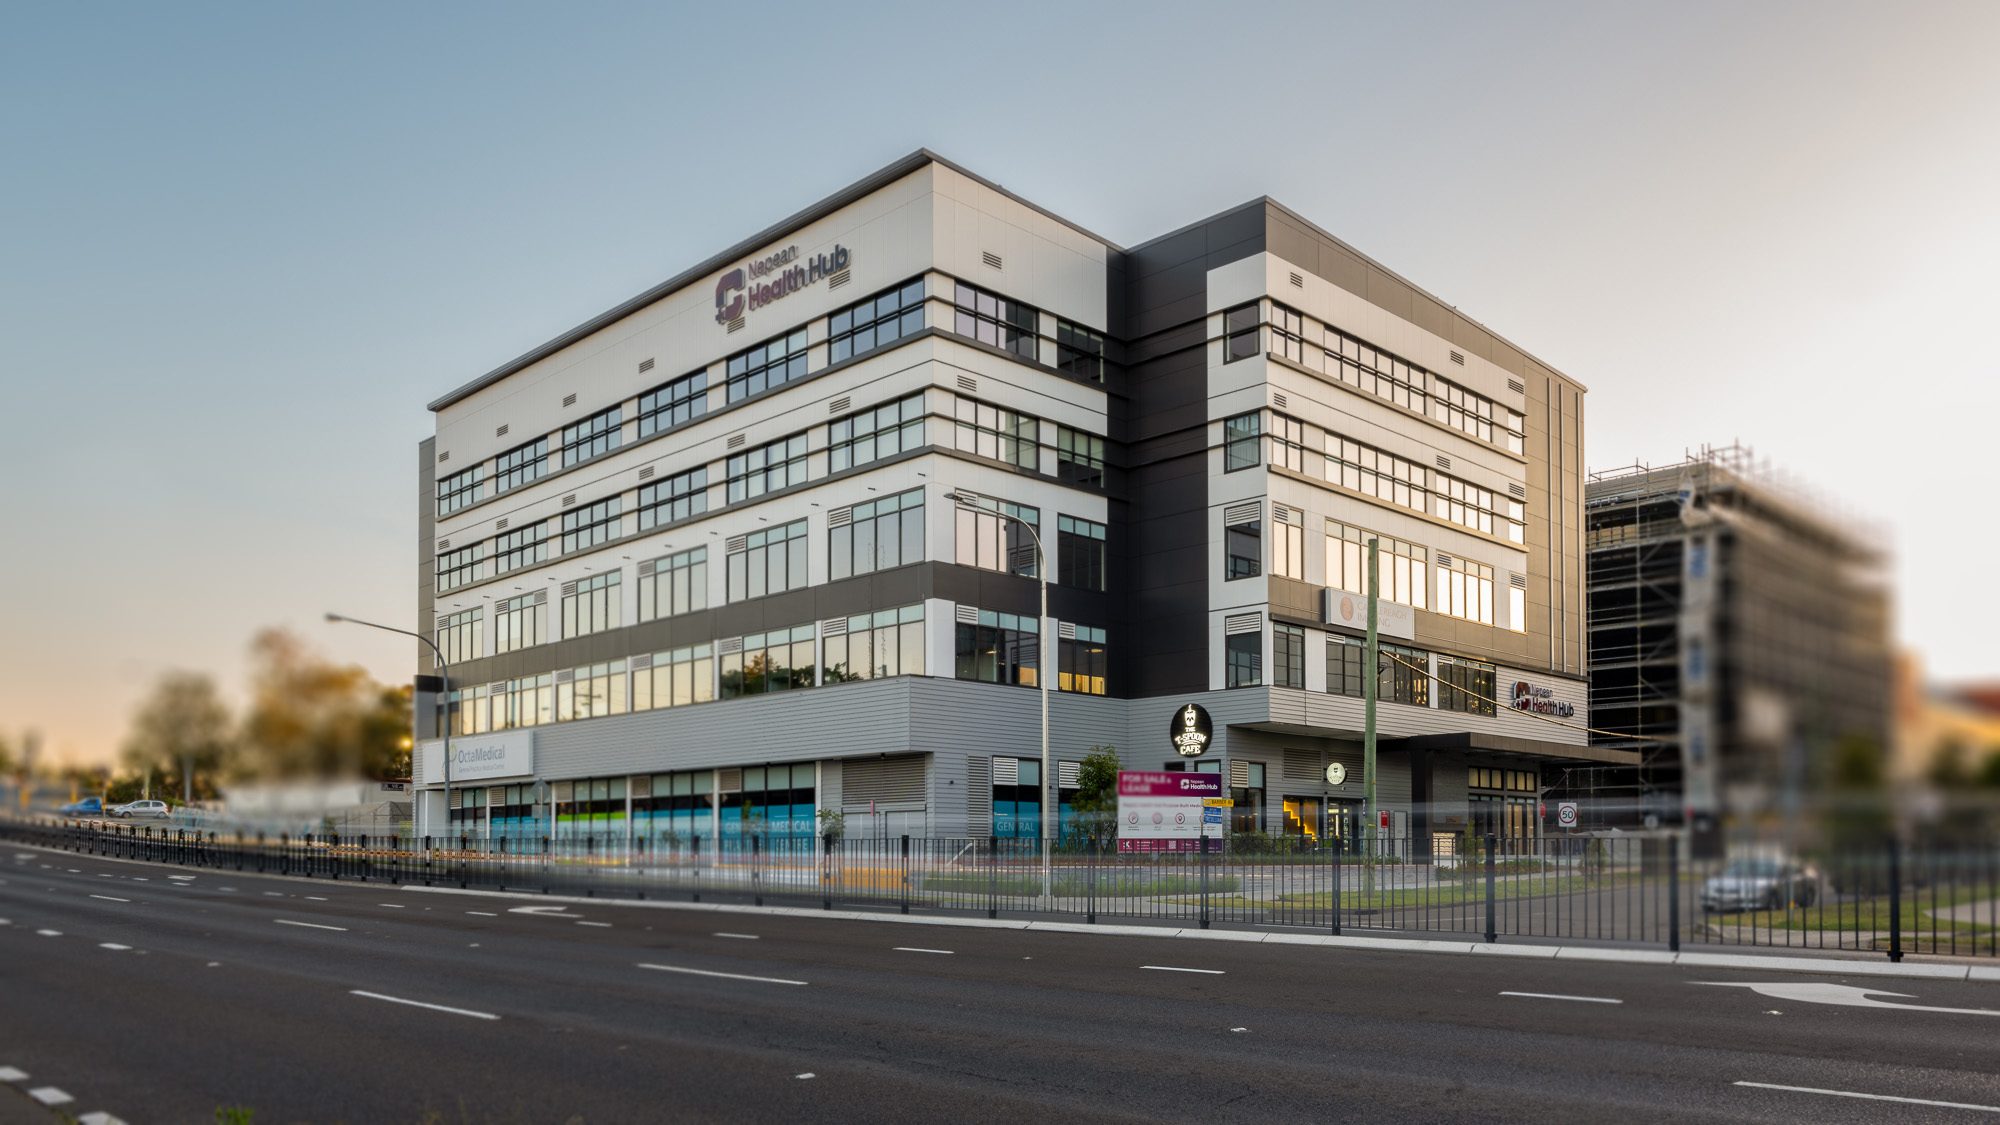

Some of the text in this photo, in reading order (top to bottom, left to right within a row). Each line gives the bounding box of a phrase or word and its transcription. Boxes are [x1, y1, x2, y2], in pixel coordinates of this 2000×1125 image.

[748, 245, 798, 280] Nepean
[748, 244, 850, 311] Health Hub
[1532, 697, 1575, 717] Health Hub
[1174, 732, 1207, 745] T-SPOON
[458, 744, 505, 763] OctaMedical
[1180, 745, 1201, 755] CAFE
[1562, 810, 1574, 819] 50
[997, 822, 1034, 831] GENRAL
